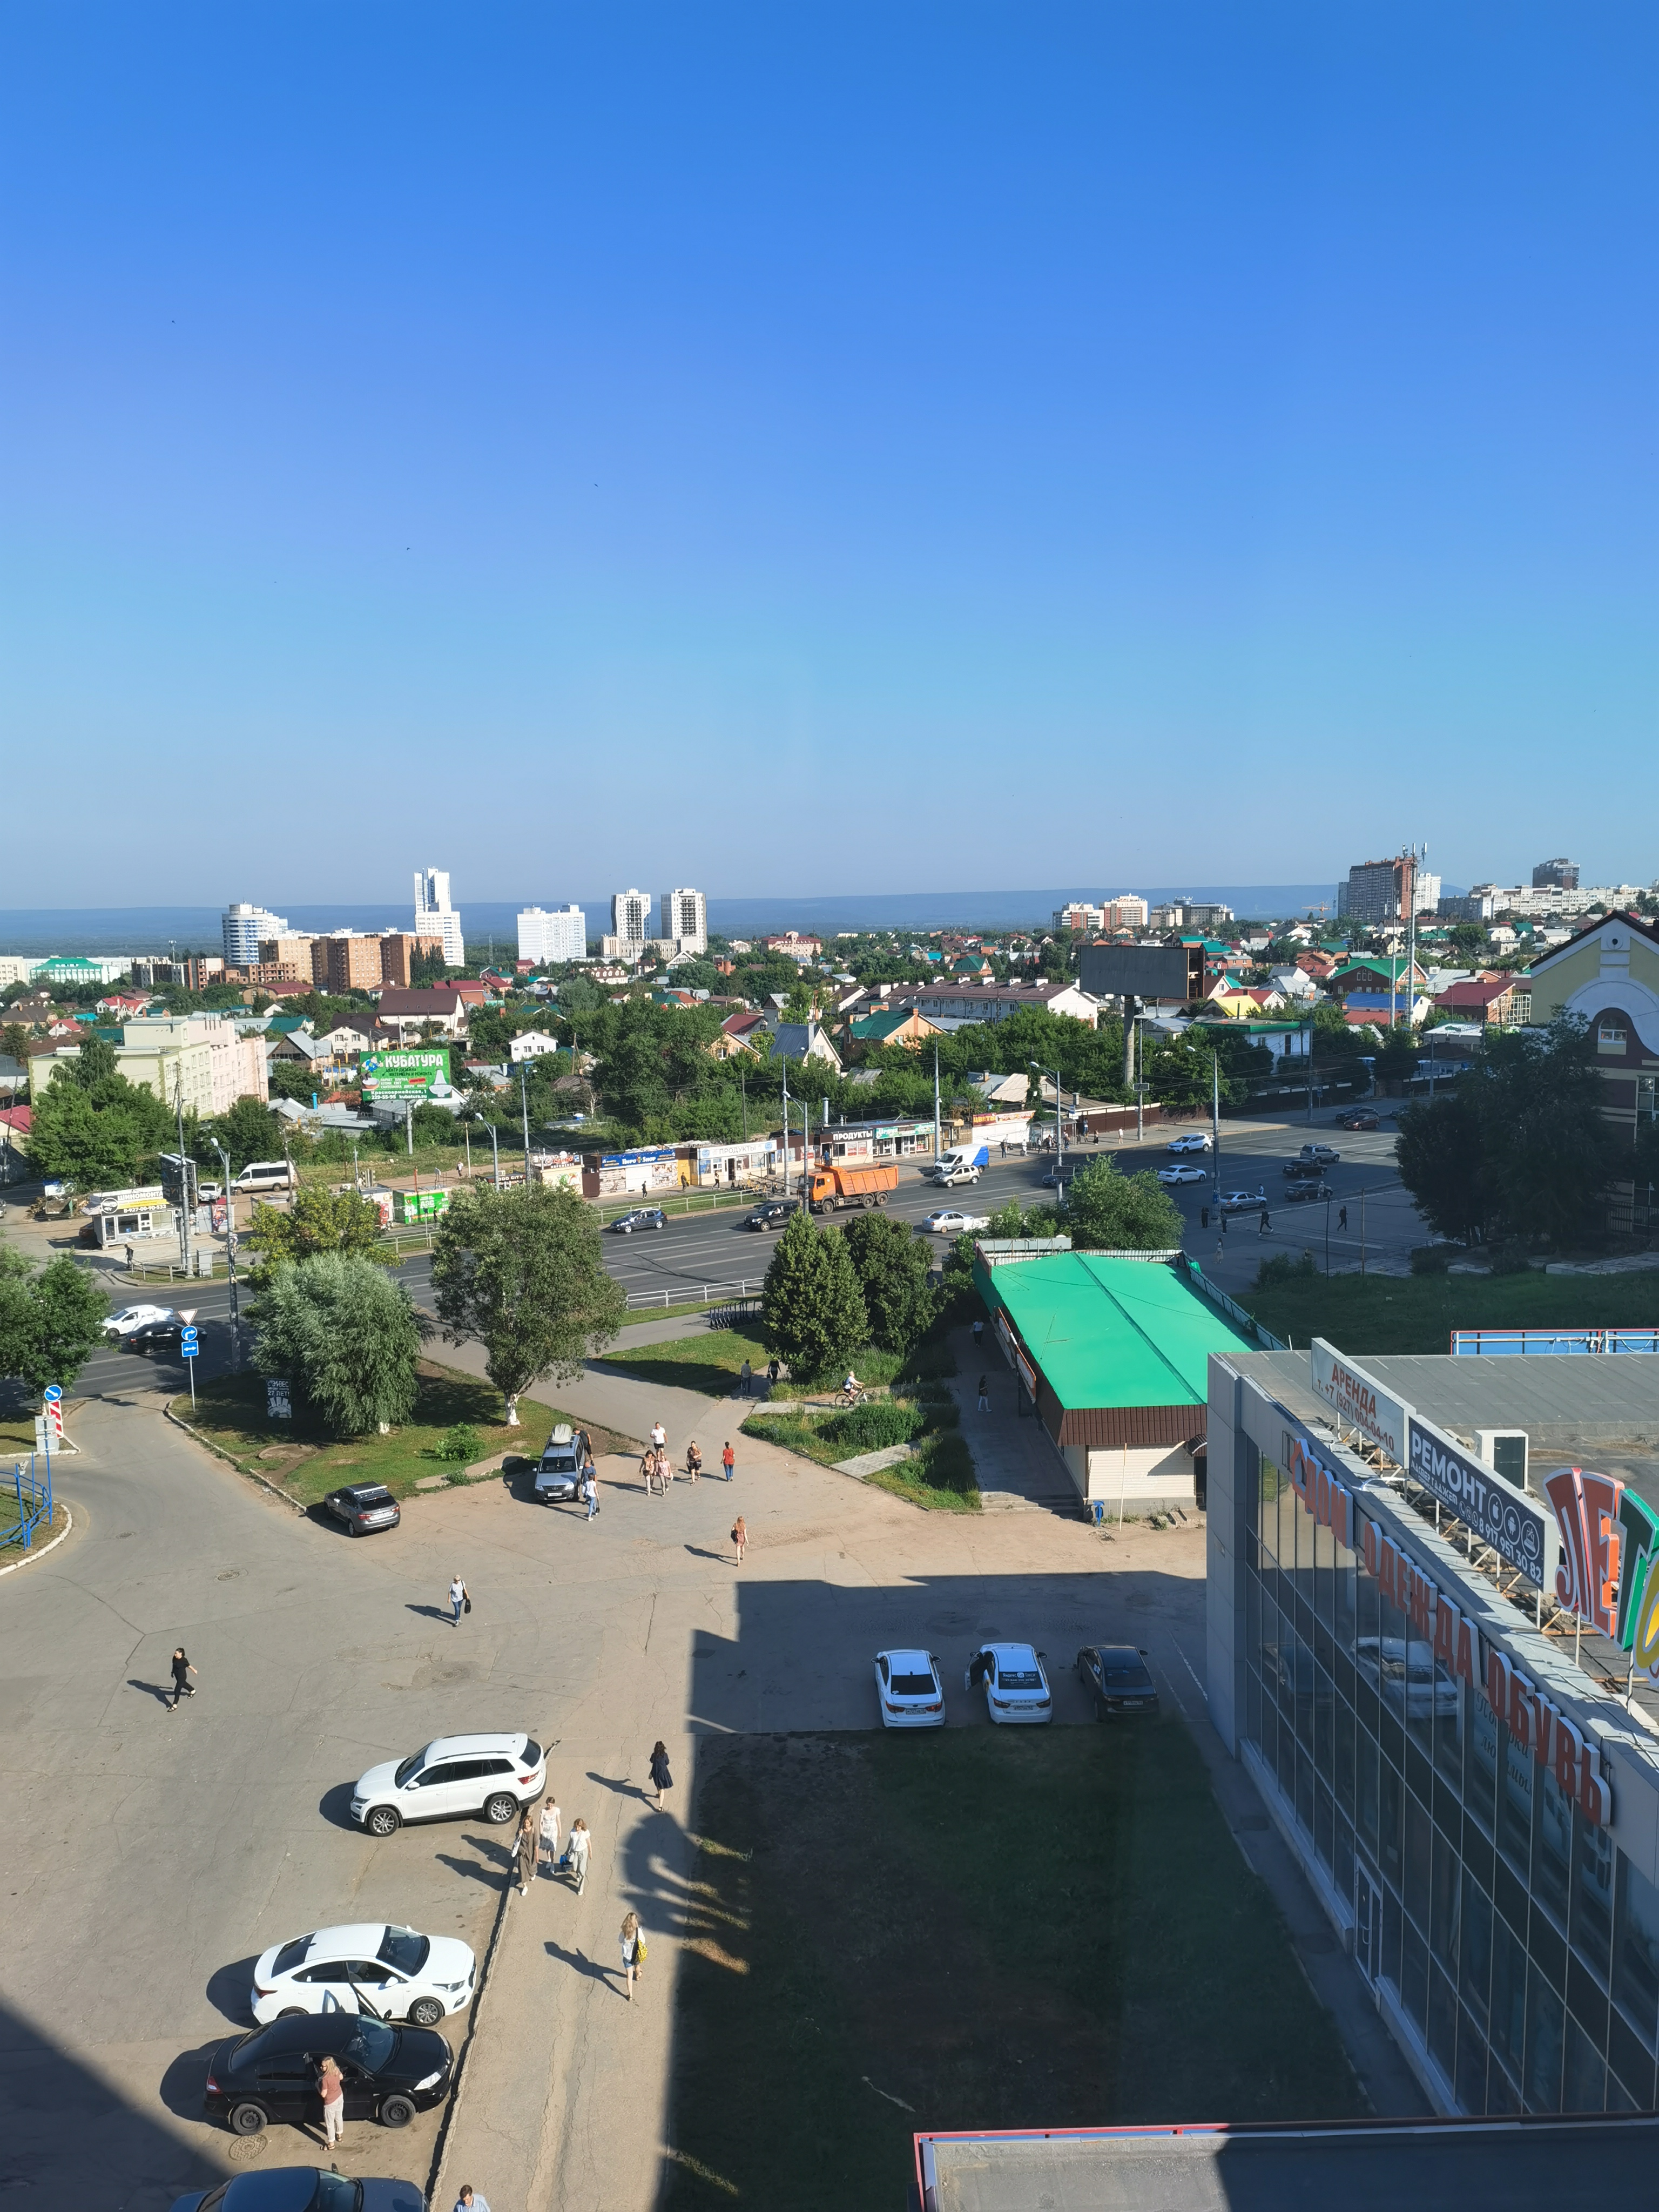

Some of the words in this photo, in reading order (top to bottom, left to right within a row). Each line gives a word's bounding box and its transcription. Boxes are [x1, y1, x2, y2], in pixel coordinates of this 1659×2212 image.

[385, 1054, 443, 1068] КУБАТУРА
[719, 1146, 756, 1154] ПРОДУКТЫ
[833, 1130, 873, 1141] ПРОДУКТЫ
[117, 1191, 163, 1201] ШИНОМОНТА
[1325, 1384, 1334, 1399] +7
[1337, 1391, 1353, 1420] (927)
[1355, 1407, 1394, 1452] 004-04-10
[1332, 1363, 1377, 1419] АРЕНДА
[1412, 1430, 1487, 1513] РЕМОНТ
[1479, 1518, 1484, 1534] 8
[1486, 1523, 1498, 1546] 917
[1500, 1536, 1514, 1561] 951
[1516, 1549, 1528, 1572] 30
[1529, 1562, 1542, 1584] 82
[1305, 1454, 1353, 1549] ДОМ
[1365, 1521, 1482, 1689] ОДЕЖДА
[1488, 1651, 1611, 1826] ОБУВЬ
